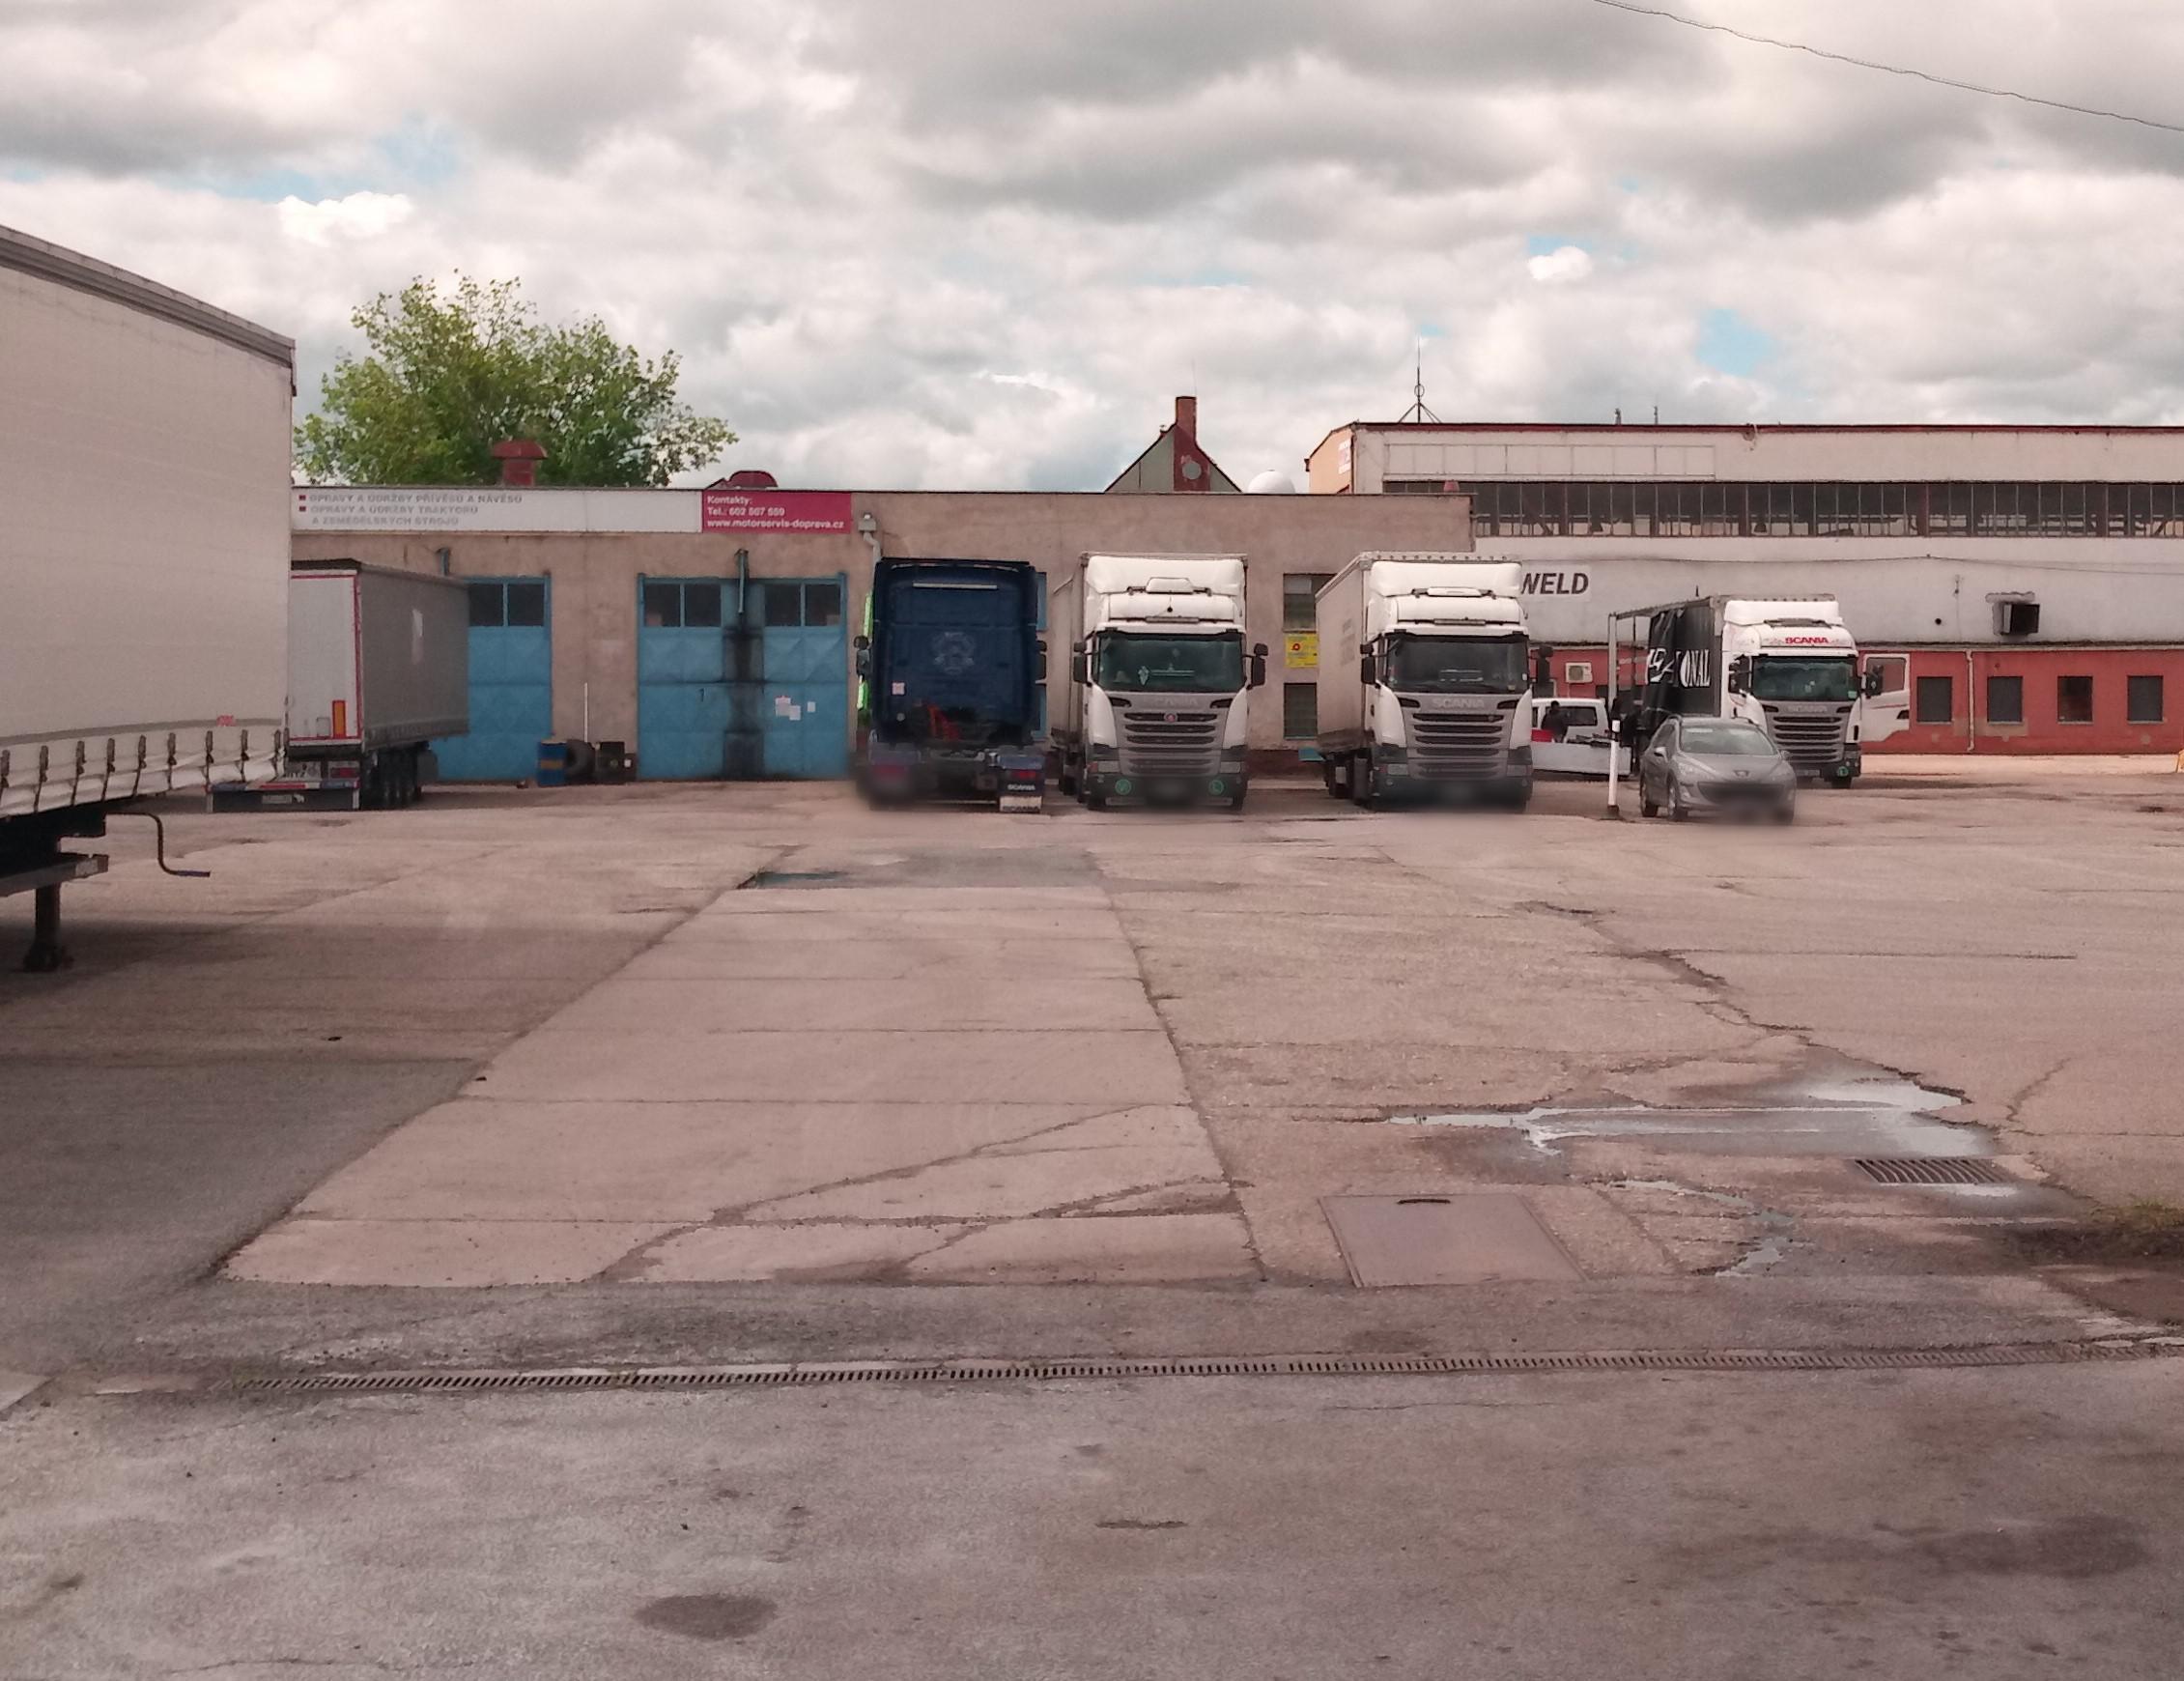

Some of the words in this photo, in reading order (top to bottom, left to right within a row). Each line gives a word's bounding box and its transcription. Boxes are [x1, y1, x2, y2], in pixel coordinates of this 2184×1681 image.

[357, 494, 364, 502] A
[467, 494, 473, 503] A
[358, 505, 365, 514] A
[1784, 636, 1829, 645] SCANIA
